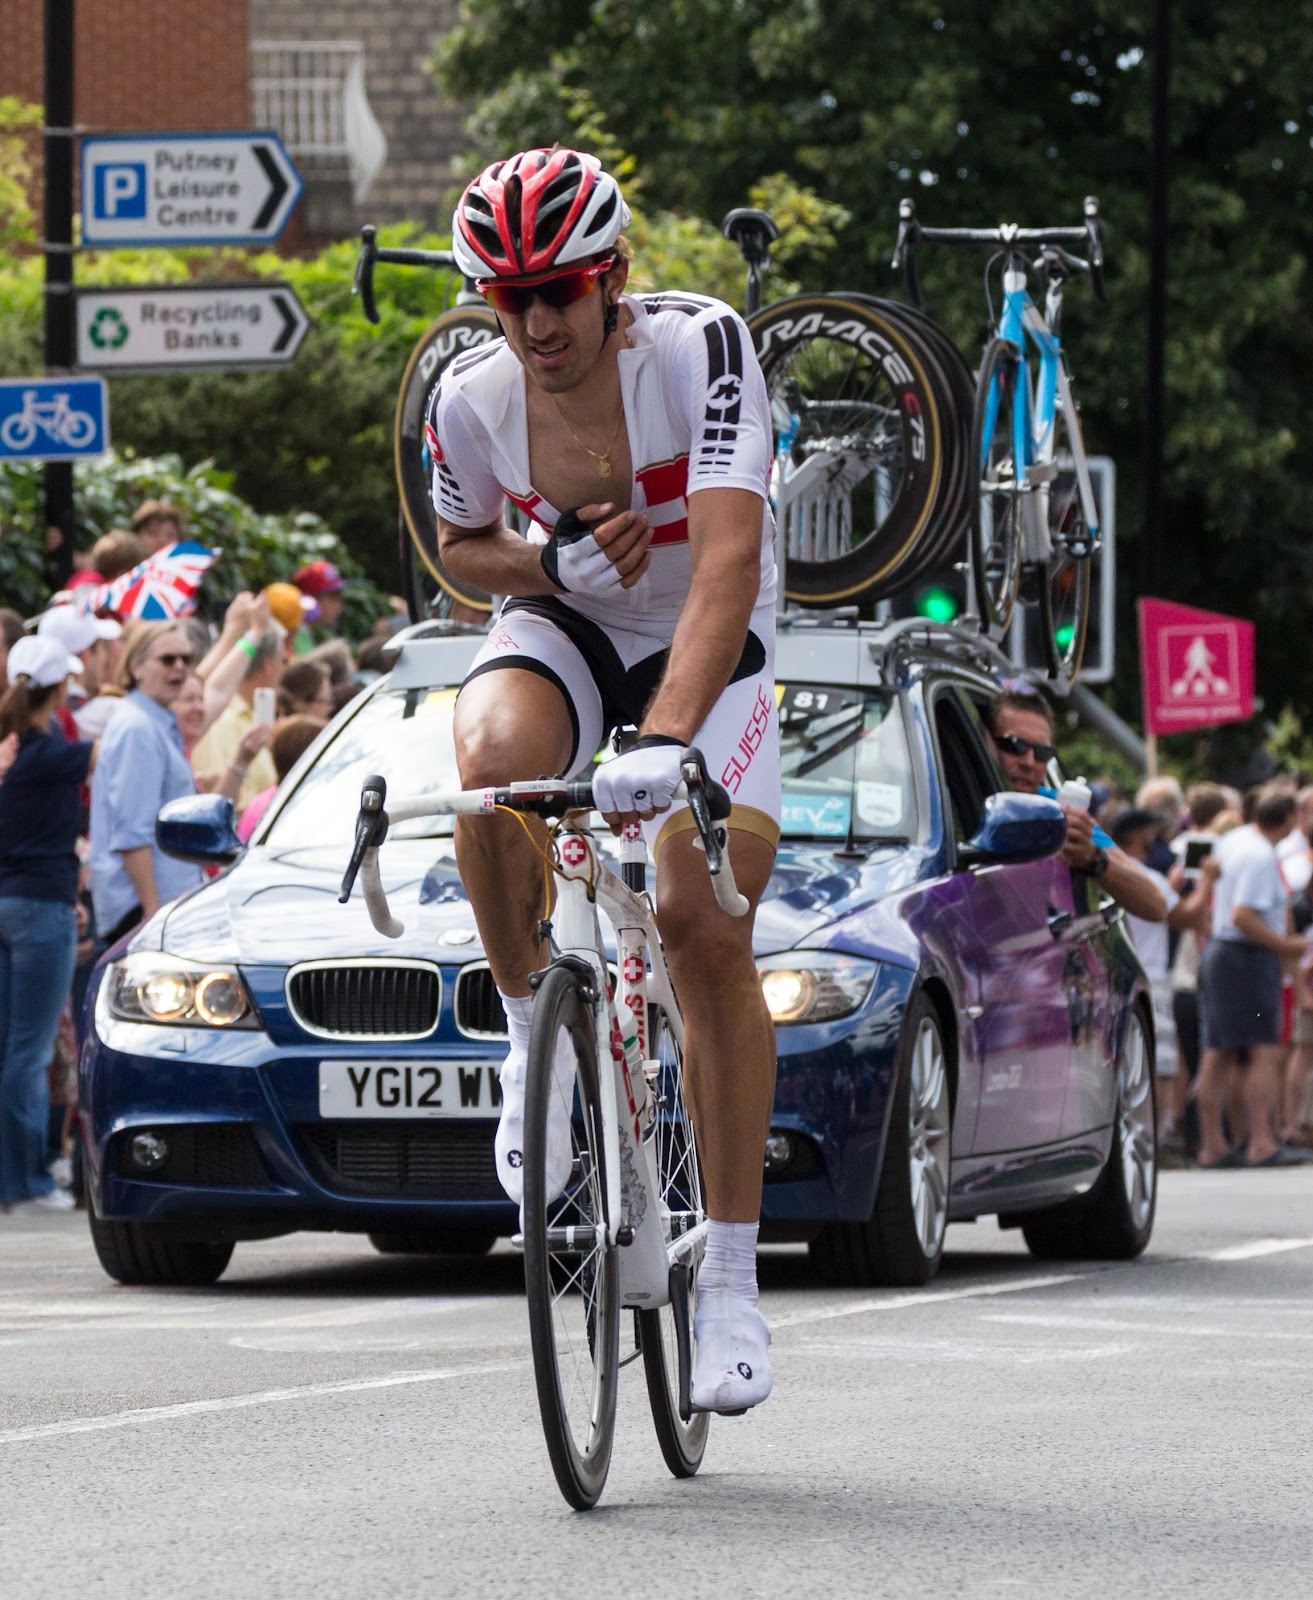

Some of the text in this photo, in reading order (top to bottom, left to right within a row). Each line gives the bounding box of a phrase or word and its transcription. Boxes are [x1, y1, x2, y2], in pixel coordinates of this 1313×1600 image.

[155, 149, 239, 174] Putney
[104, 167, 138, 216] P
[154, 177, 241, 200] Leisure
[157, 204, 239, 227] Centre
[141, 301, 262, 326] Recycling
[164, 328, 241, 351] Banks
[793, 691, 829, 710] 81
[721, 683, 772, 795] SUISSE
[347, 1067, 442, 1107] YG12
